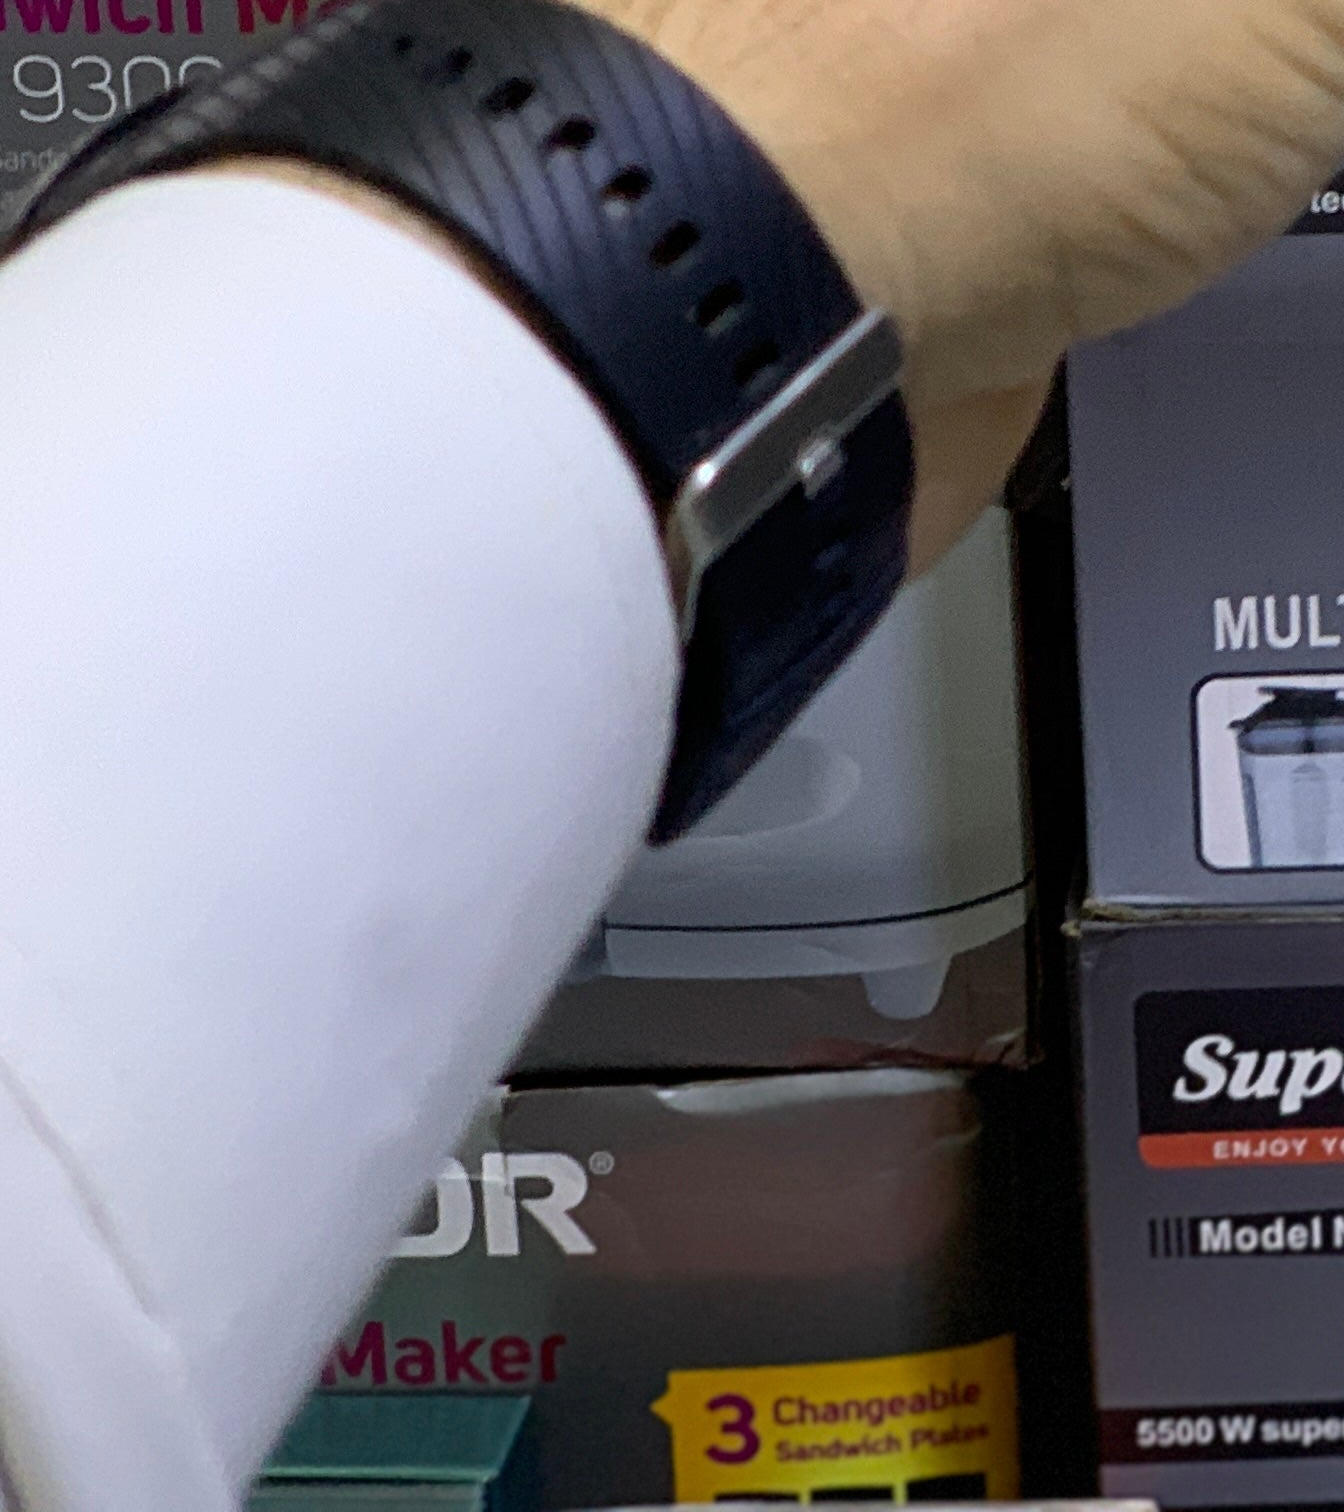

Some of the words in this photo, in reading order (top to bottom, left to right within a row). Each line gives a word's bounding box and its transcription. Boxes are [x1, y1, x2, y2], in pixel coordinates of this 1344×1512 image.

[1213, 1137, 1308, 1160] ENJOY
[1199, 1213, 1321, 1254] Model
[705, 1393, 761, 1465] 3
[773, 1381, 982, 1426] Changeable
[776, 1433, 901, 1463] Sandwich
[910, 1423, 990, 1451] Plates
[1136, 1417, 1214, 1448] 5500
[1220, 1414, 1256, 1446] W
